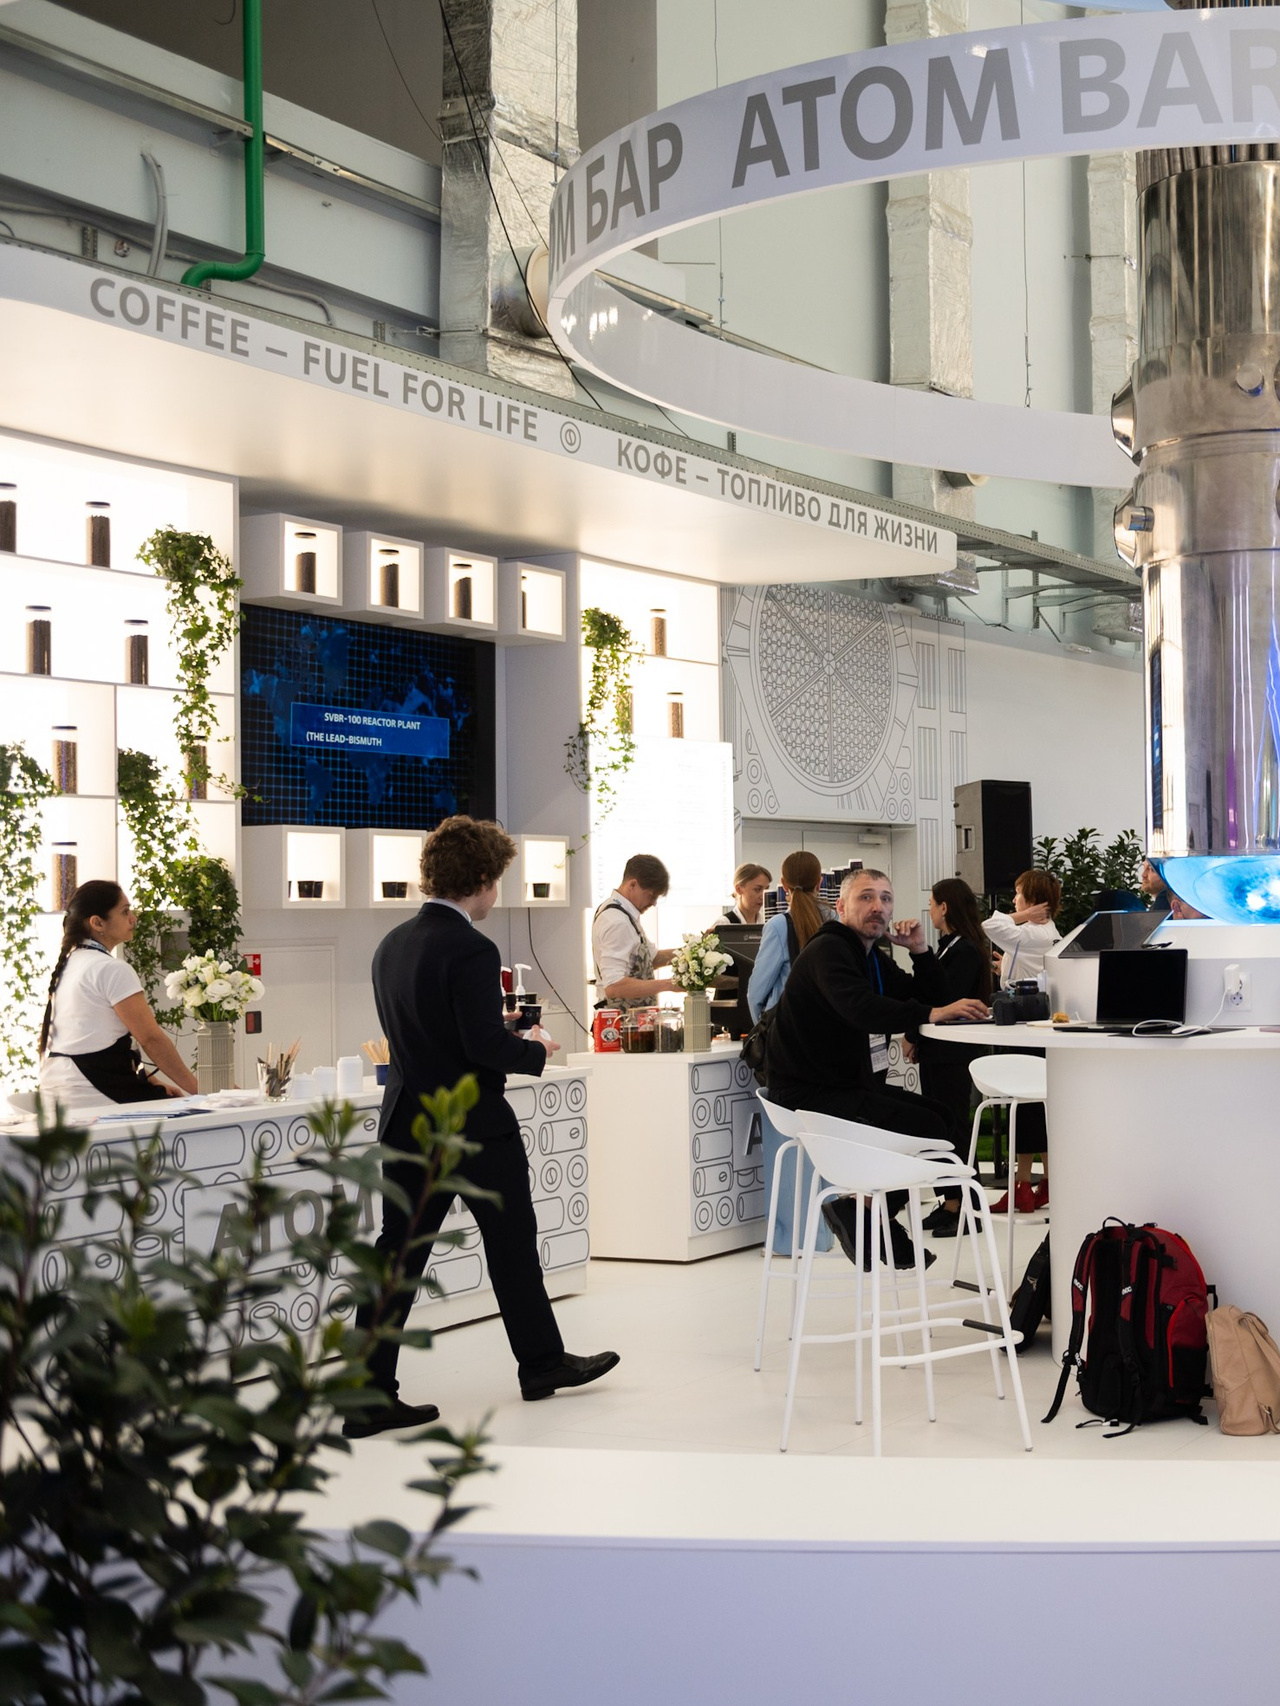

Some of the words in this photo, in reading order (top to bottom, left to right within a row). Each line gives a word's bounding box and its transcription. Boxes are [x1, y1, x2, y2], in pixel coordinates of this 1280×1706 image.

[732, 47, 1020, 189] ATOM
[586, 122, 683, 245] БАР
[90, 277, 250, 358] COFFEE
[303, 340, 389, 399] FUEL
[402, 371, 466, 421] FOR
[478, 395, 538, 442] LIFE
[617, 438, 687, 485] КОФЕ
[716, 468, 821, 522] ТОПЛИВО
[828, 502, 868, 536] ДЛЯ
[874, 514, 938, 554] ЖИЗНИ
[306, 731, 325, 742] (THE
[325, 734, 382, 746] LEAD-BISMUTH
[324, 712, 362, 725] SVBR-100
[362, 716, 397, 728] REACTOR
[397, 720, 421, 730] PLANT
